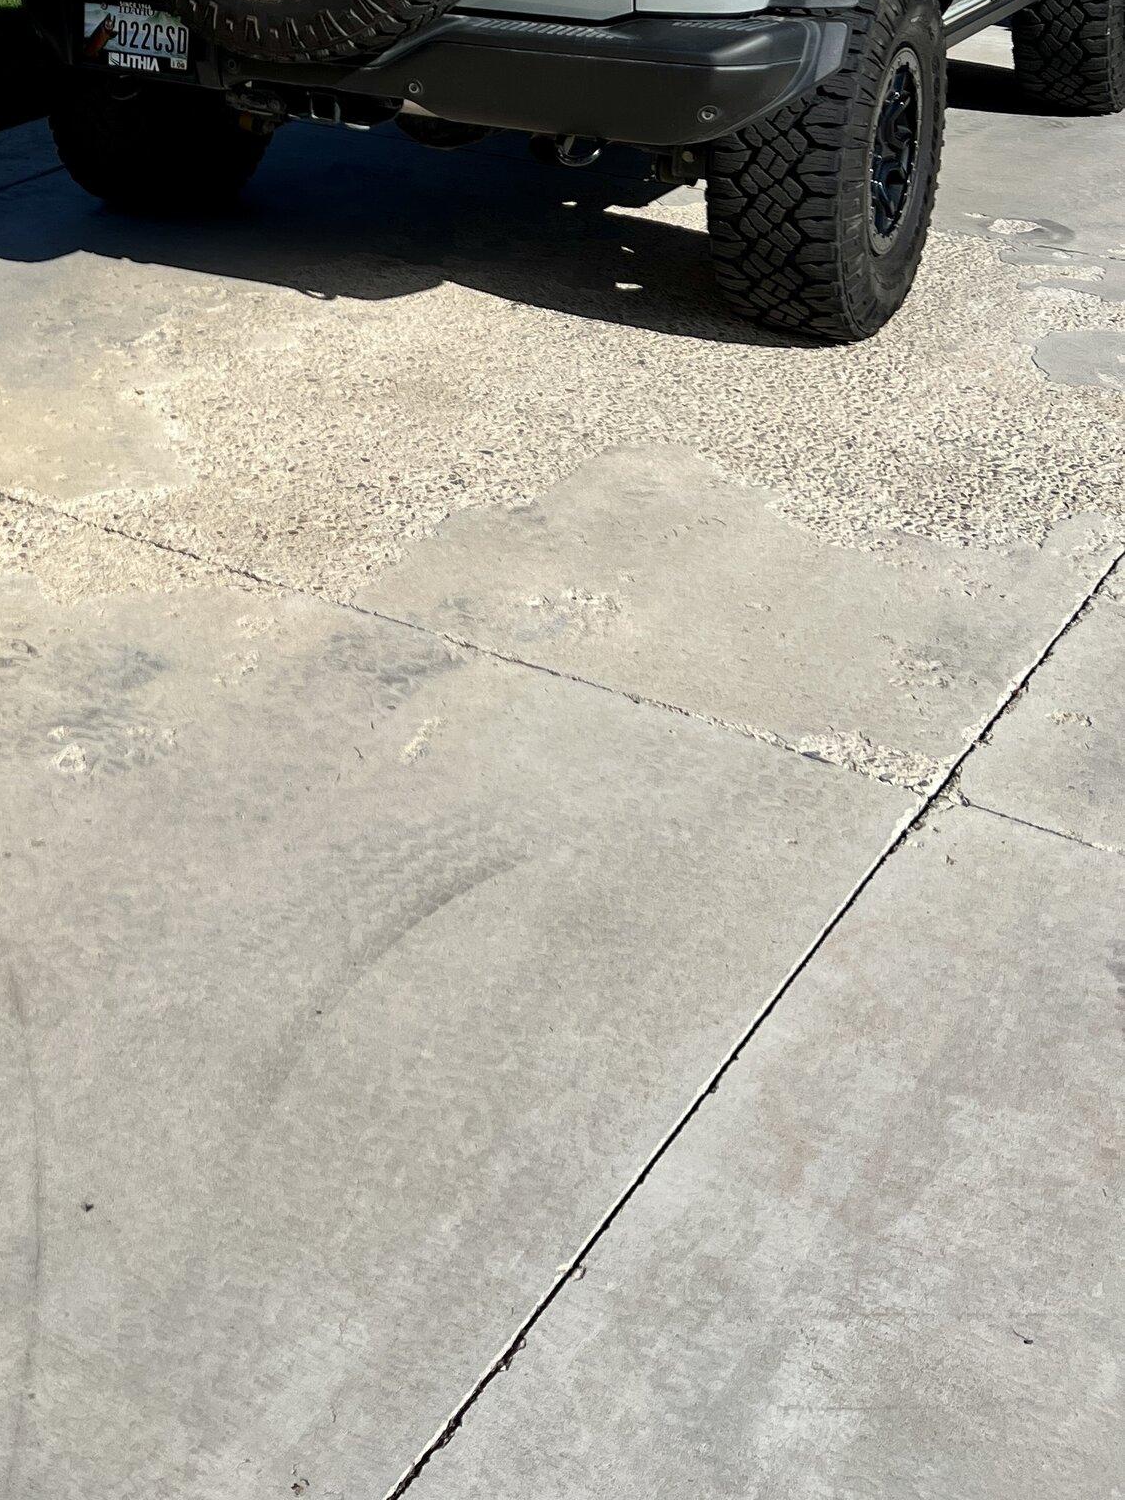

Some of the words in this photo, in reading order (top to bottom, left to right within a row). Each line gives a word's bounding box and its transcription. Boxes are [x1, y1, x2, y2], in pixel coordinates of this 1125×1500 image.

[119, 5, 155, 17] IDAHO
[118, 19, 188, 55] 022CSD
[120, 52, 160, 72] LITHIA
